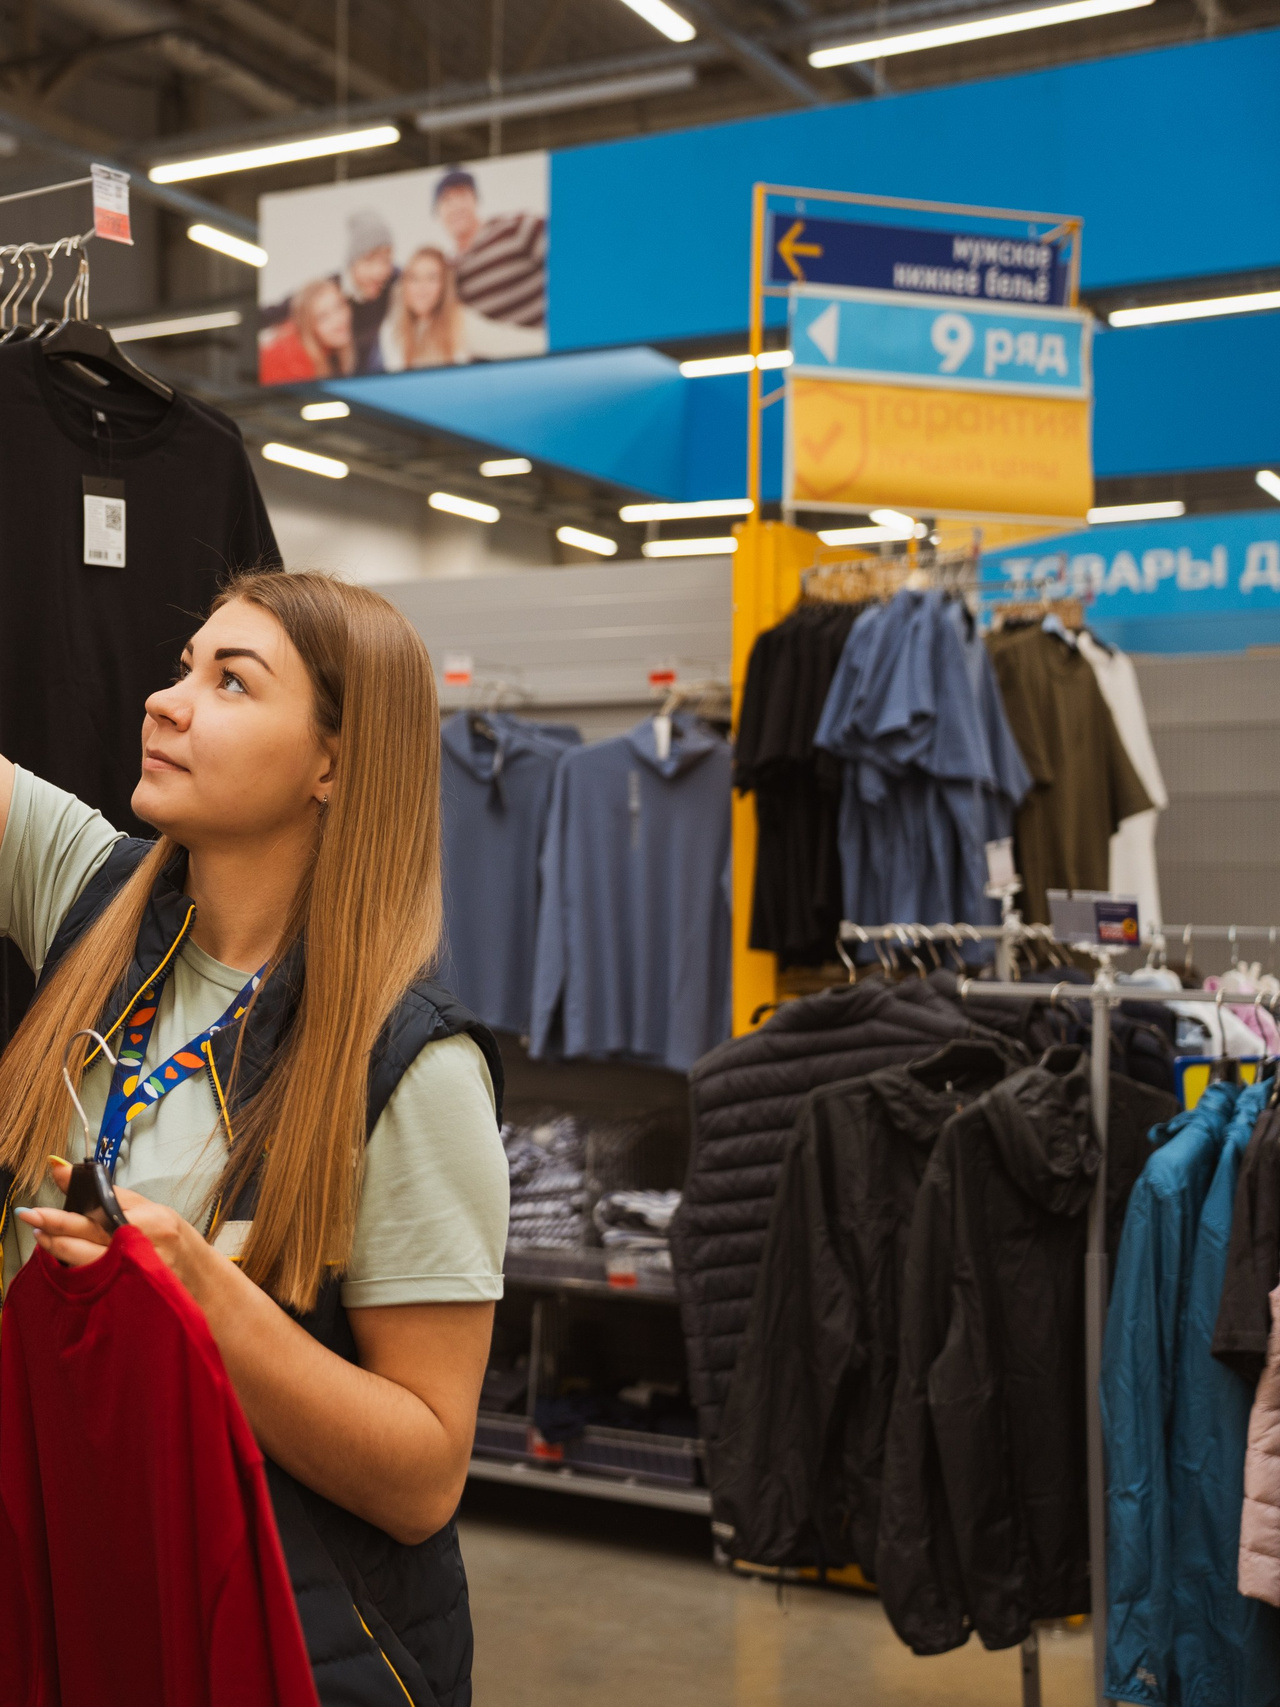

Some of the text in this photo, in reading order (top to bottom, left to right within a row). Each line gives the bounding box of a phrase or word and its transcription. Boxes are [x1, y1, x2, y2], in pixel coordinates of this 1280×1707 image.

[952, 236, 1051, 269] мужское
[893, 262, 979, 296] нижнее
[930, 311, 1069, 378] 9 ряд
